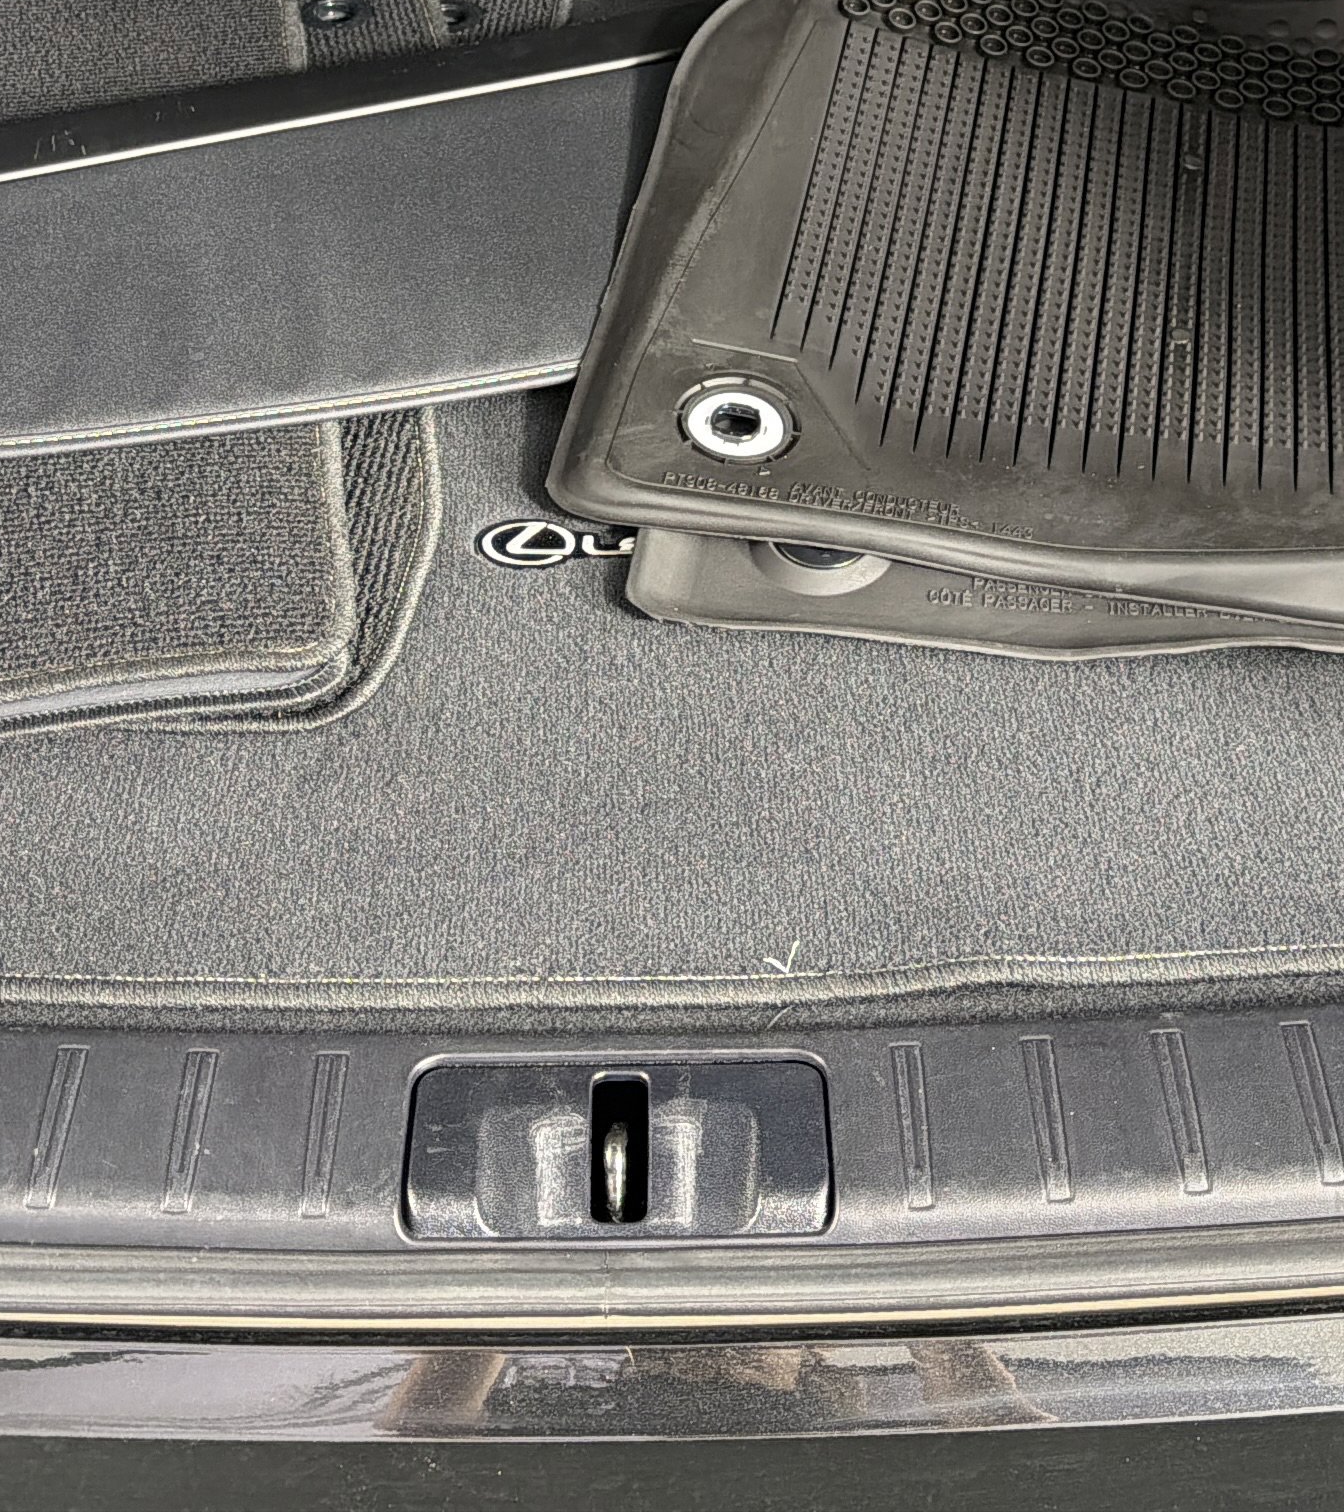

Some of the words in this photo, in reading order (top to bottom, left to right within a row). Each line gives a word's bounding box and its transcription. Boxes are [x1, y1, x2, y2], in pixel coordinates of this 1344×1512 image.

[791, 481, 845, 498] AVANT
[854, 490, 960, 516] CONDUCTEUR
[928, 587, 973, 607] CÔTÉ
[982, 593, 1073, 614] PASSAGER
